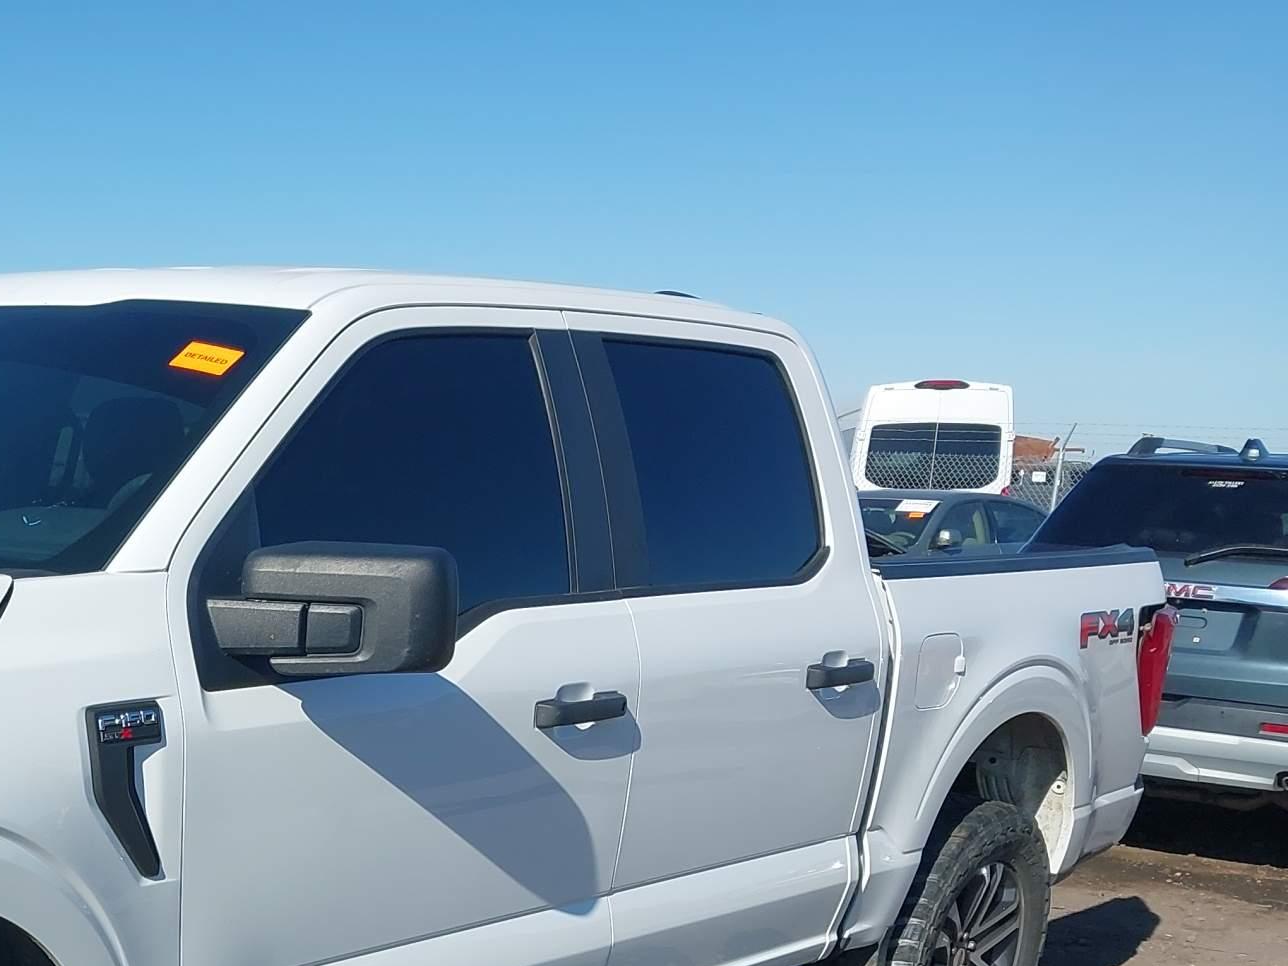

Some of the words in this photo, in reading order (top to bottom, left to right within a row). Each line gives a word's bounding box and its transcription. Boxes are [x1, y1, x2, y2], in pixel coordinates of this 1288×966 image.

[183, 351, 229, 366] DETAILED
[1164, 583, 1215, 600] MC
[1079, 607, 1135, 650] FX4
[98, 710, 158, 731] F-150
